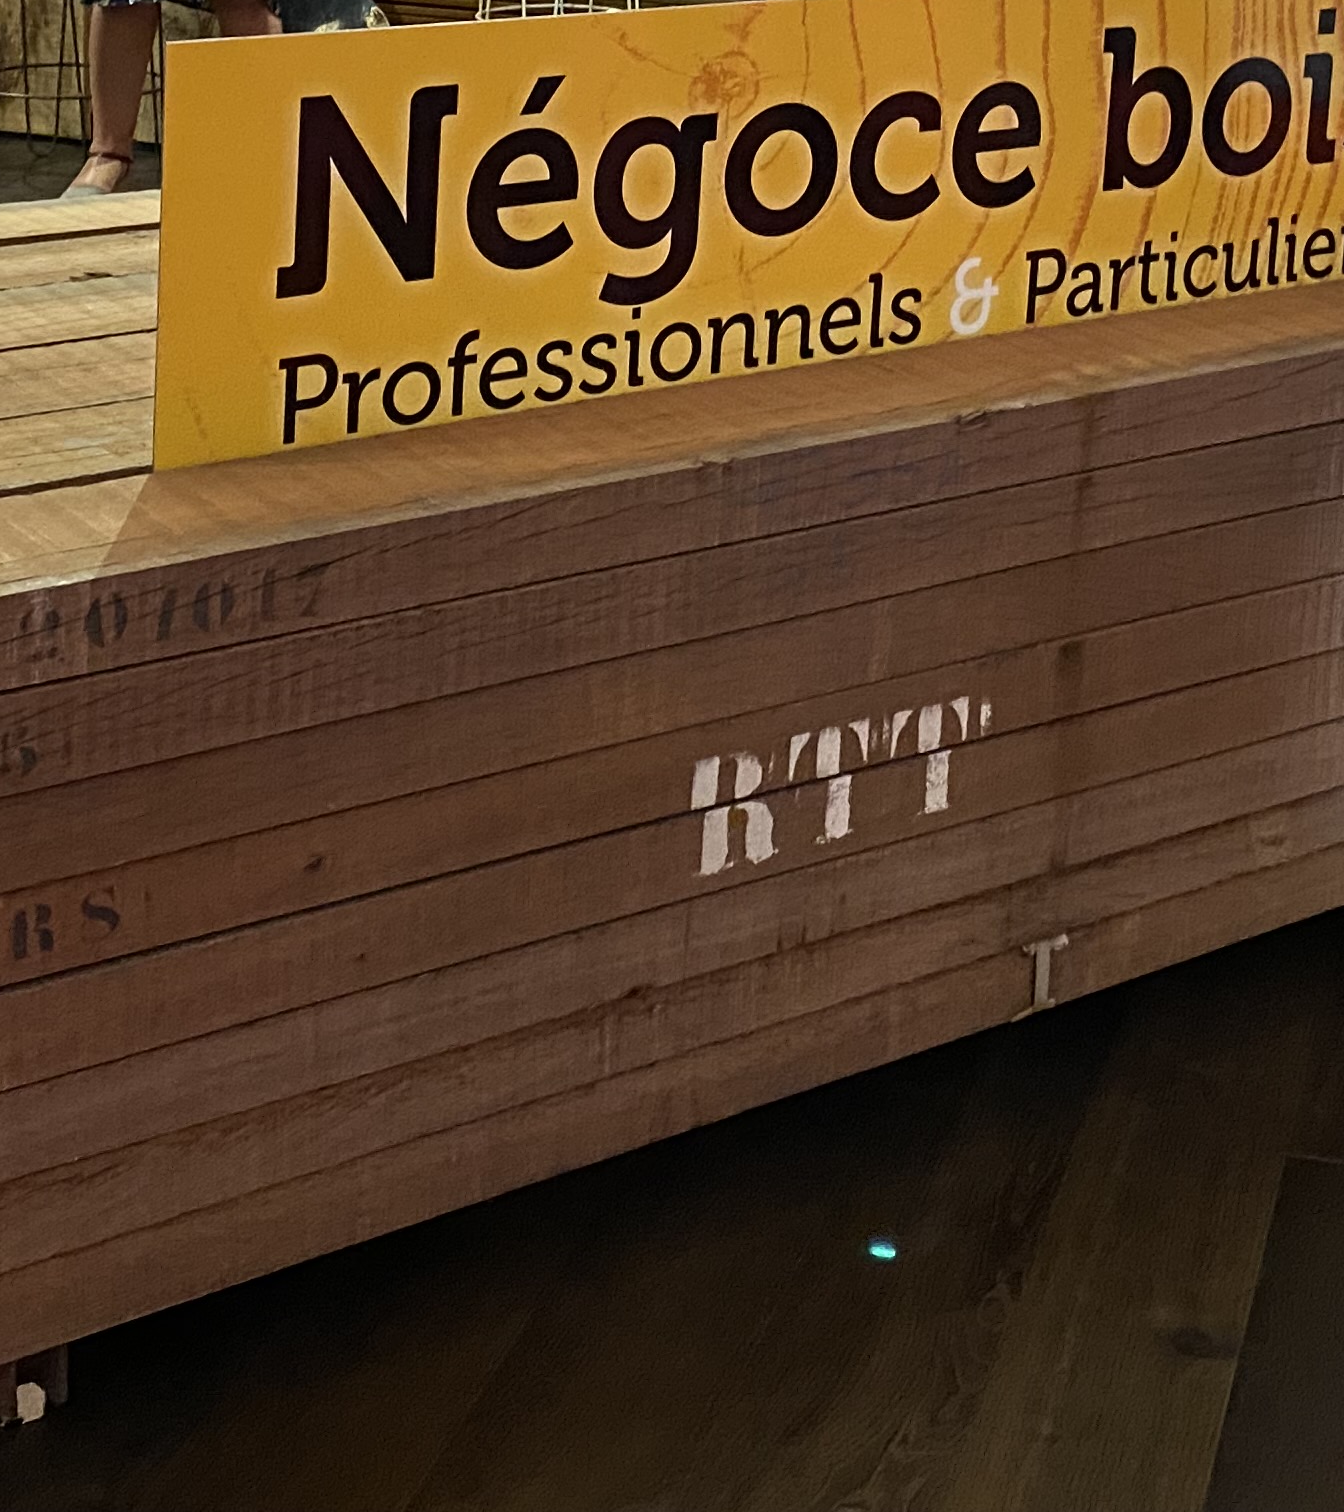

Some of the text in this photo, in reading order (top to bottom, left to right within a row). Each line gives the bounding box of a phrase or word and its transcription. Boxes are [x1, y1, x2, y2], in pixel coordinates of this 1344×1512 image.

[274, 74, 1044, 306] Négoce
[277, 274, 924, 445] Professionnels
[949, 257, 999, 337] &
